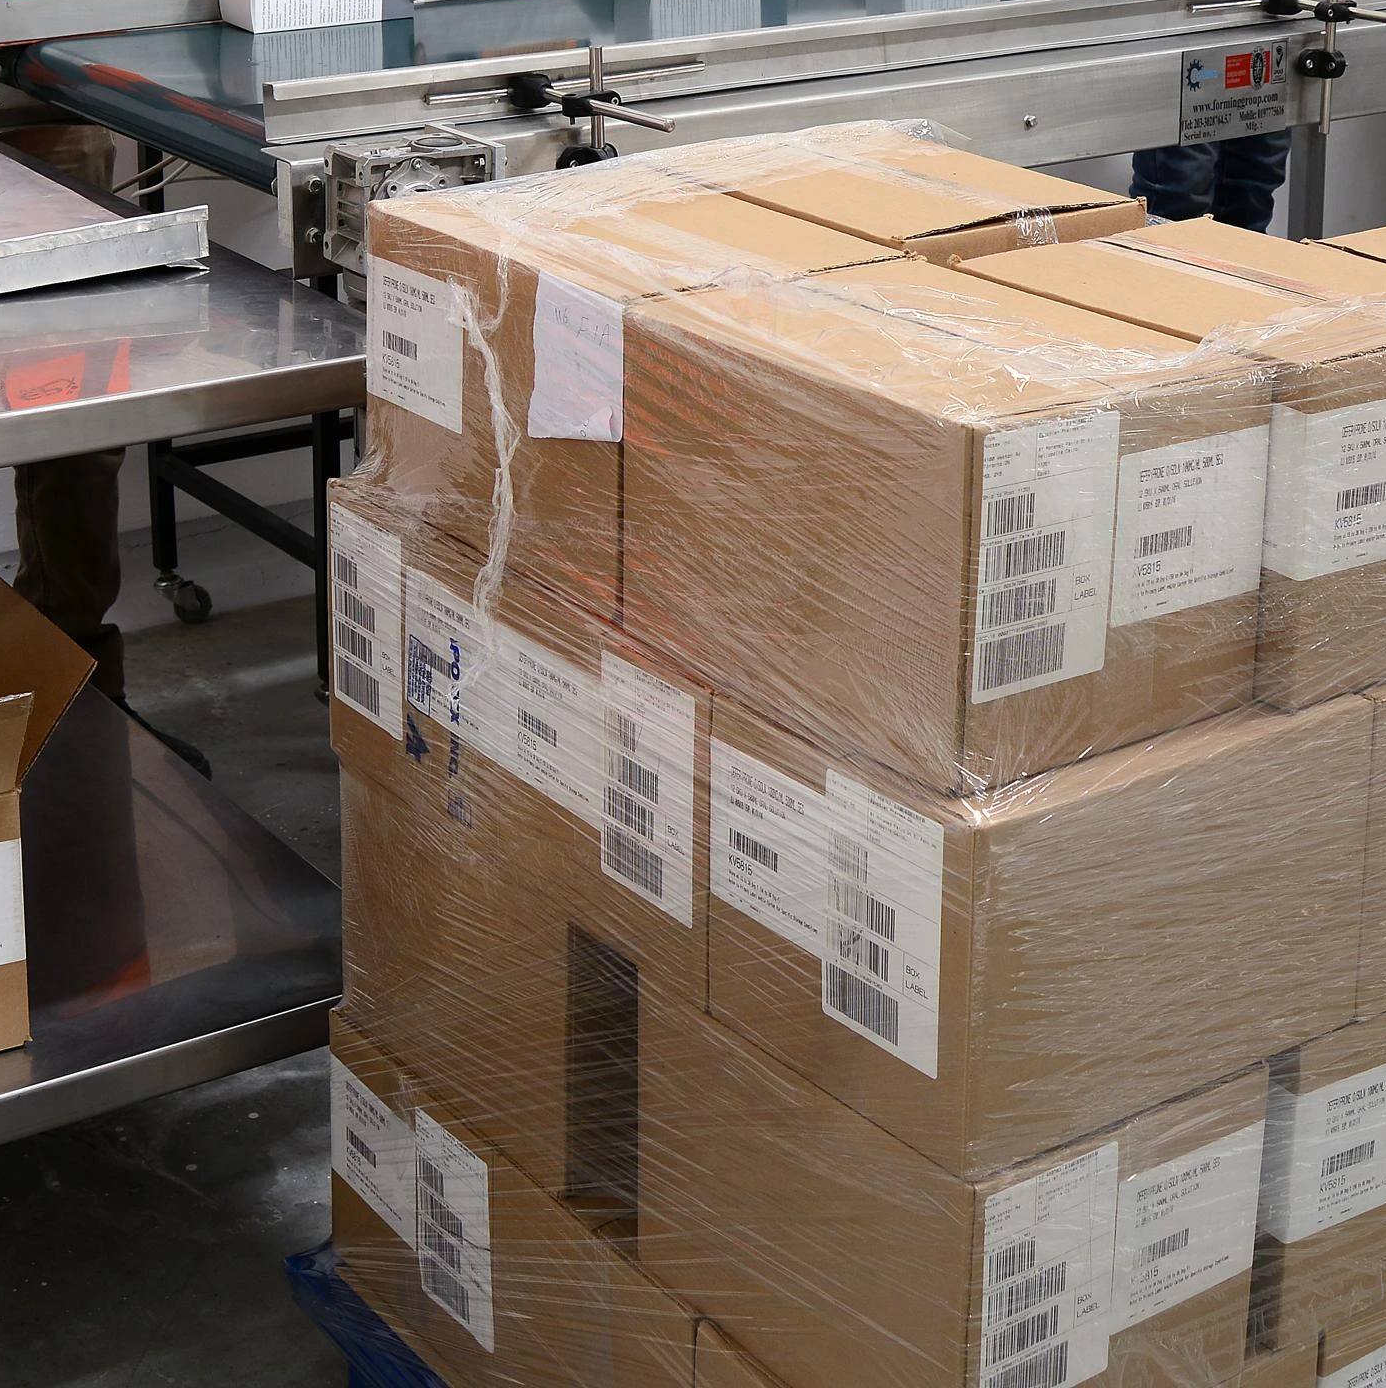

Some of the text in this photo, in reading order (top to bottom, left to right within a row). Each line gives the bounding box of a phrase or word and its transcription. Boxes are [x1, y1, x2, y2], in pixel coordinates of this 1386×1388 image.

[1192, 93, 1279, 113] www.forminggroup.com
[1183, 131, 1201, 141] Serial
[1076, 572, 1091, 585] BOX
[1074, 588, 1097, 601] LABEL
[728, 854, 754, 876] KV5815
[905, 965, 920, 980] BOX
[905, 979, 929, 1000] LABEL
[1319, 1174, 1346, 1194] KV5815
[1077, 1292, 1092, 1305] BOX
[1076, 1302, 1100, 1318] LABEL
